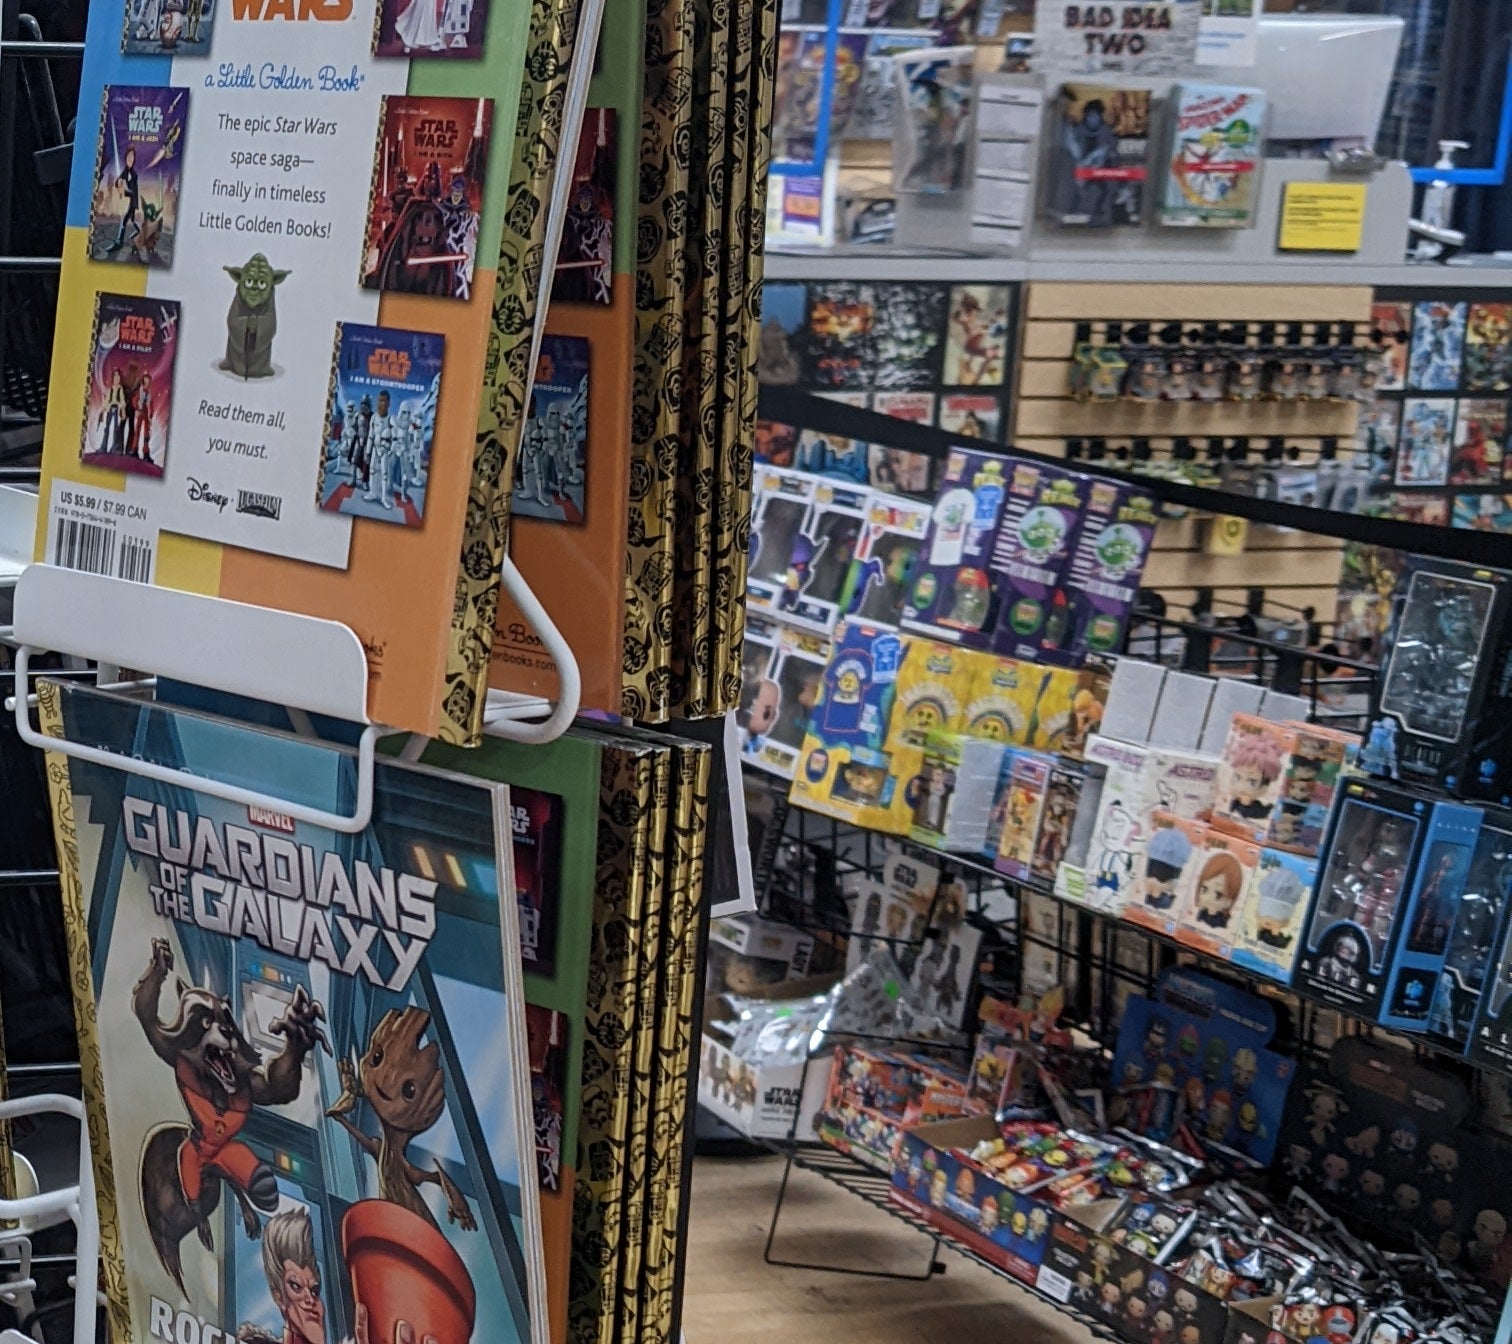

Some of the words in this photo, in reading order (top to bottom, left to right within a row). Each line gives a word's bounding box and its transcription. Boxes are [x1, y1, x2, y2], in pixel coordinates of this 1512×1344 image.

[1083, 32, 1147, 57] TWO
[204, 72, 216, 88] a
[217, 62, 257, 91] Little
[258, 63, 314, 92] Golden
[128, 105, 164, 120] STAR
[217, 113, 243, 132] The
[244, 116, 272, 137] epic
[273, 115, 302, 135] Star
[303, 118, 339, 137] Wars
[128, 119, 164, 133] WARS
[414, 119, 459, 135] STAR
[413, 130, 459, 149] WARS
[229, 149, 271, 170] space
[211, 179, 252, 203] finally
[253, 183, 268, 201] in
[269, 184, 327, 205] timeless
[198, 211, 232, 231] Little
[234, 214, 284, 235] Golden
[286, 218, 332, 240] Books!
[197, 398, 231, 421] Read
[231, 402, 262, 426] them
[263, 407, 287, 432] all,
[207, 436, 232, 456] you
[232, 440, 269, 461] must.
[60, 491, 73, 504] US
[73, 493, 96, 510] $5.99
[102, 497, 127, 516] $7.99
[126, 504, 148, 522] CAN
[509, 622, 543, 647] Boo
[122, 795, 439, 940] GUARDIANS
[160, 860, 187, 893] OF
[149, 884, 191, 922] THE
[189, 871, 429, 993] GALAXY
